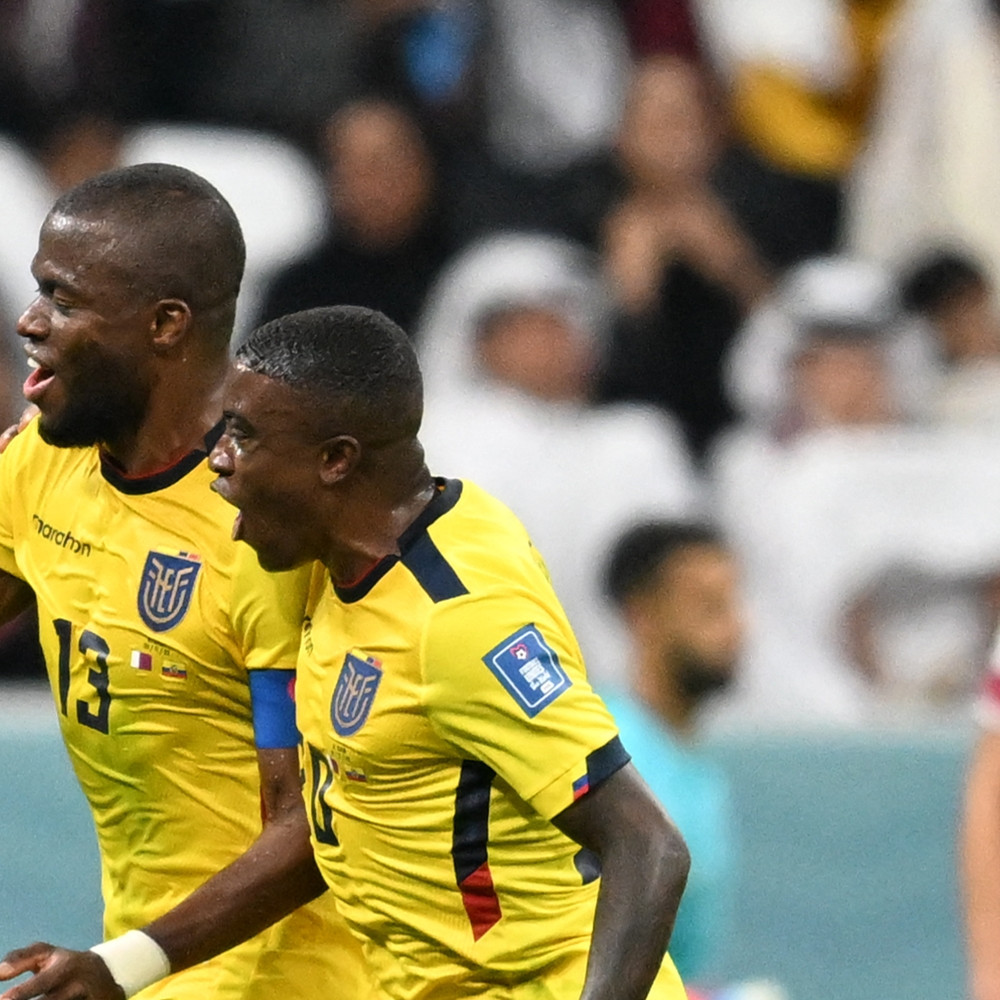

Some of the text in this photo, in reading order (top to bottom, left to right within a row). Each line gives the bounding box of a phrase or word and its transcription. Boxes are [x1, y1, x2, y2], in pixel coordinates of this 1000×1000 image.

[33, 514, 92, 557] marahon
[52, 617, 112, 735] 13
[300, 741, 340, 848] 0
